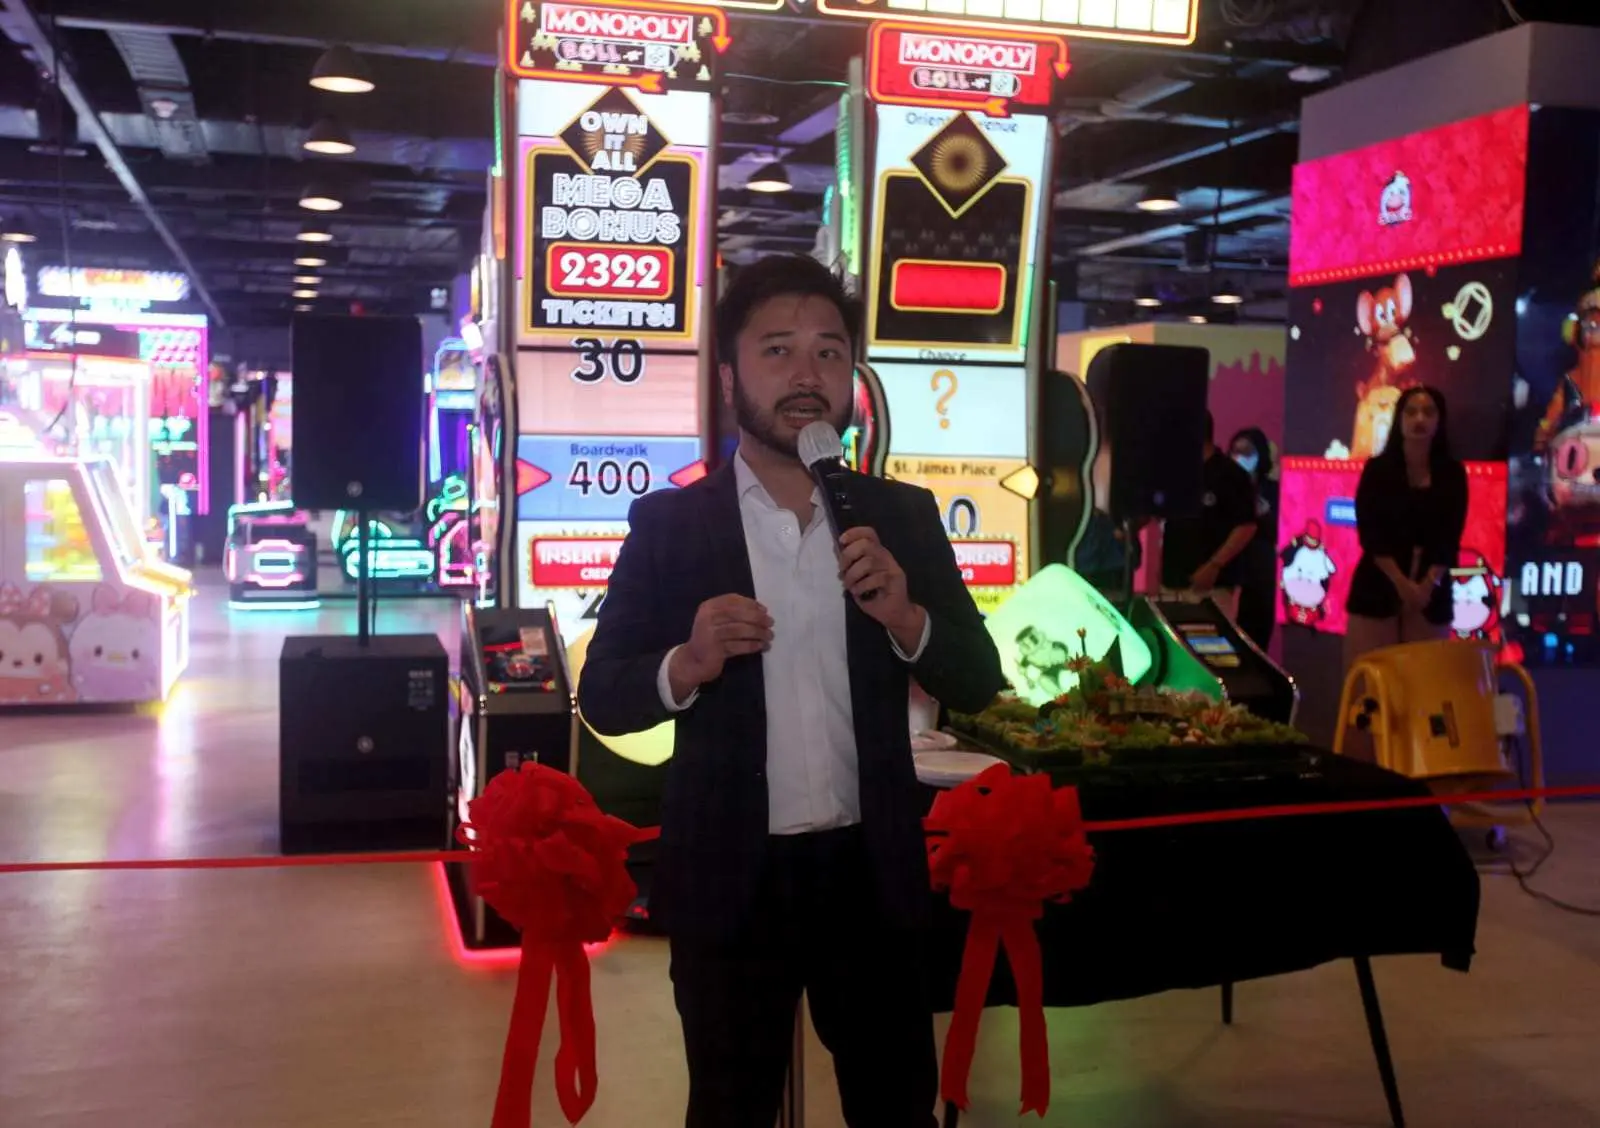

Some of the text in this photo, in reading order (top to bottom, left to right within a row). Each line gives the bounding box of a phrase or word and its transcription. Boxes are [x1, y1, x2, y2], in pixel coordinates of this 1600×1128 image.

[546, 9, 689, 43] MONOPOLY
[904, 38, 1031, 68] MONOPOLY
[580, 111, 648, 135] OWN
[603, 134, 625, 150] IT
[591, 151, 637, 171] ALL
[552, 173, 674, 210] MEGA
[541, 206, 681, 244] BONUS
[560, 252, 661, 289] 2322
[573, 337, 643, 383] 30
[570, 443, 648, 456] Boardwalk
[568, 460, 650, 496] 400
[917, 462, 956, 475] James
[961, 463, 997, 475] Place
[540, 546, 602, 565] INSERT
[1522, 561, 1583, 596] AND
